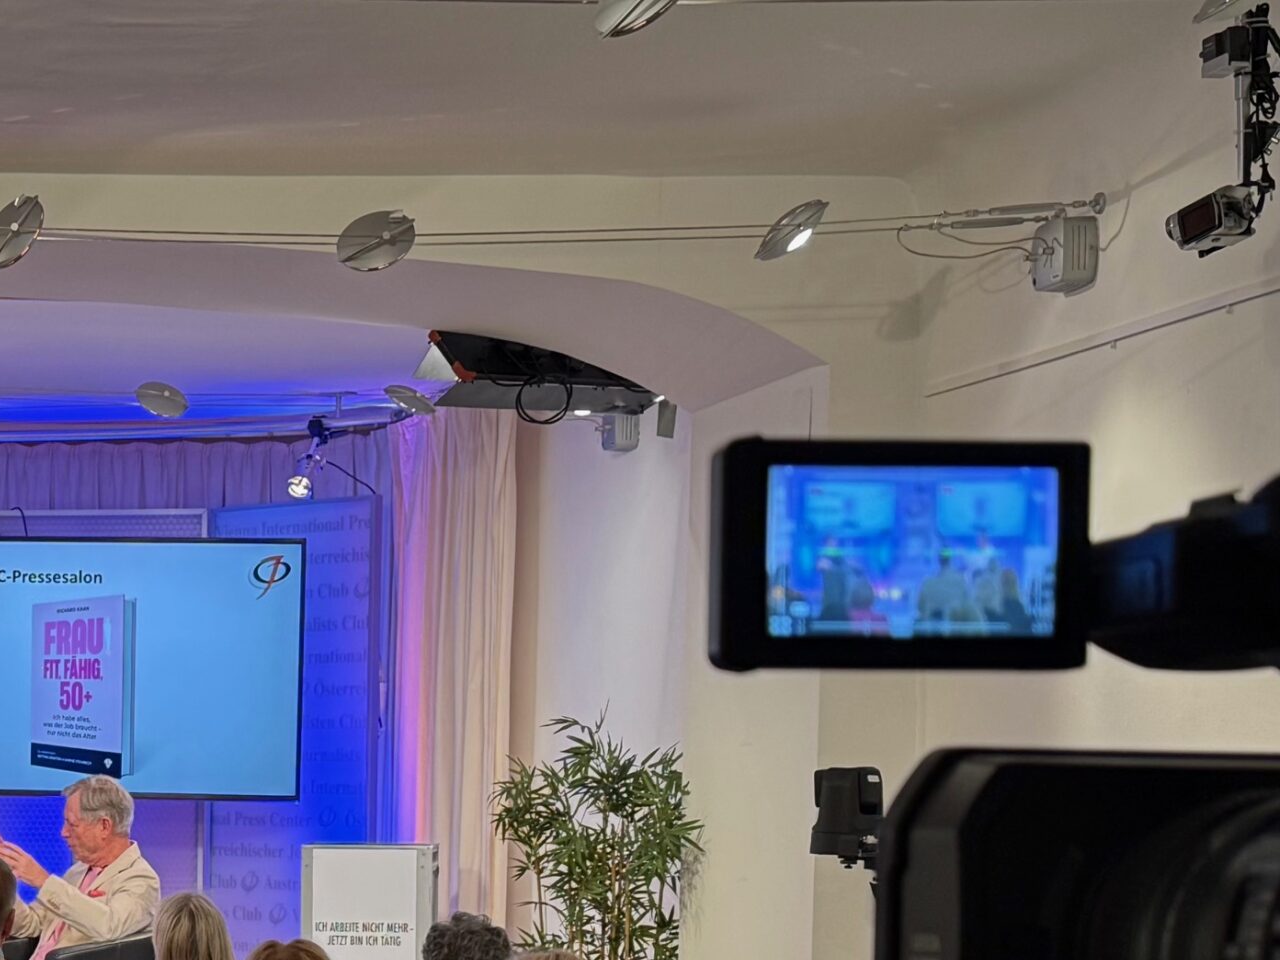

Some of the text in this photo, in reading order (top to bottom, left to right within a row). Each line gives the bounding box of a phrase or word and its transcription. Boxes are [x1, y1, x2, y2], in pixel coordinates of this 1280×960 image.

[262, 515, 344, 536] International
[317, 582, 349, 600] Club
[44, 617, 104, 655] FRAU
[43, 658, 61, 680] FIT.
[59, 681, 93, 711] 50+
[232, 904, 262, 921] Club
[315, 921, 328, 932] ICH
[329, 921, 359, 933] ARBEITE
[362, 921, 385, 933] NICHT
[327, 933, 402, 947] JETZT BIN ICH TÄTIG
